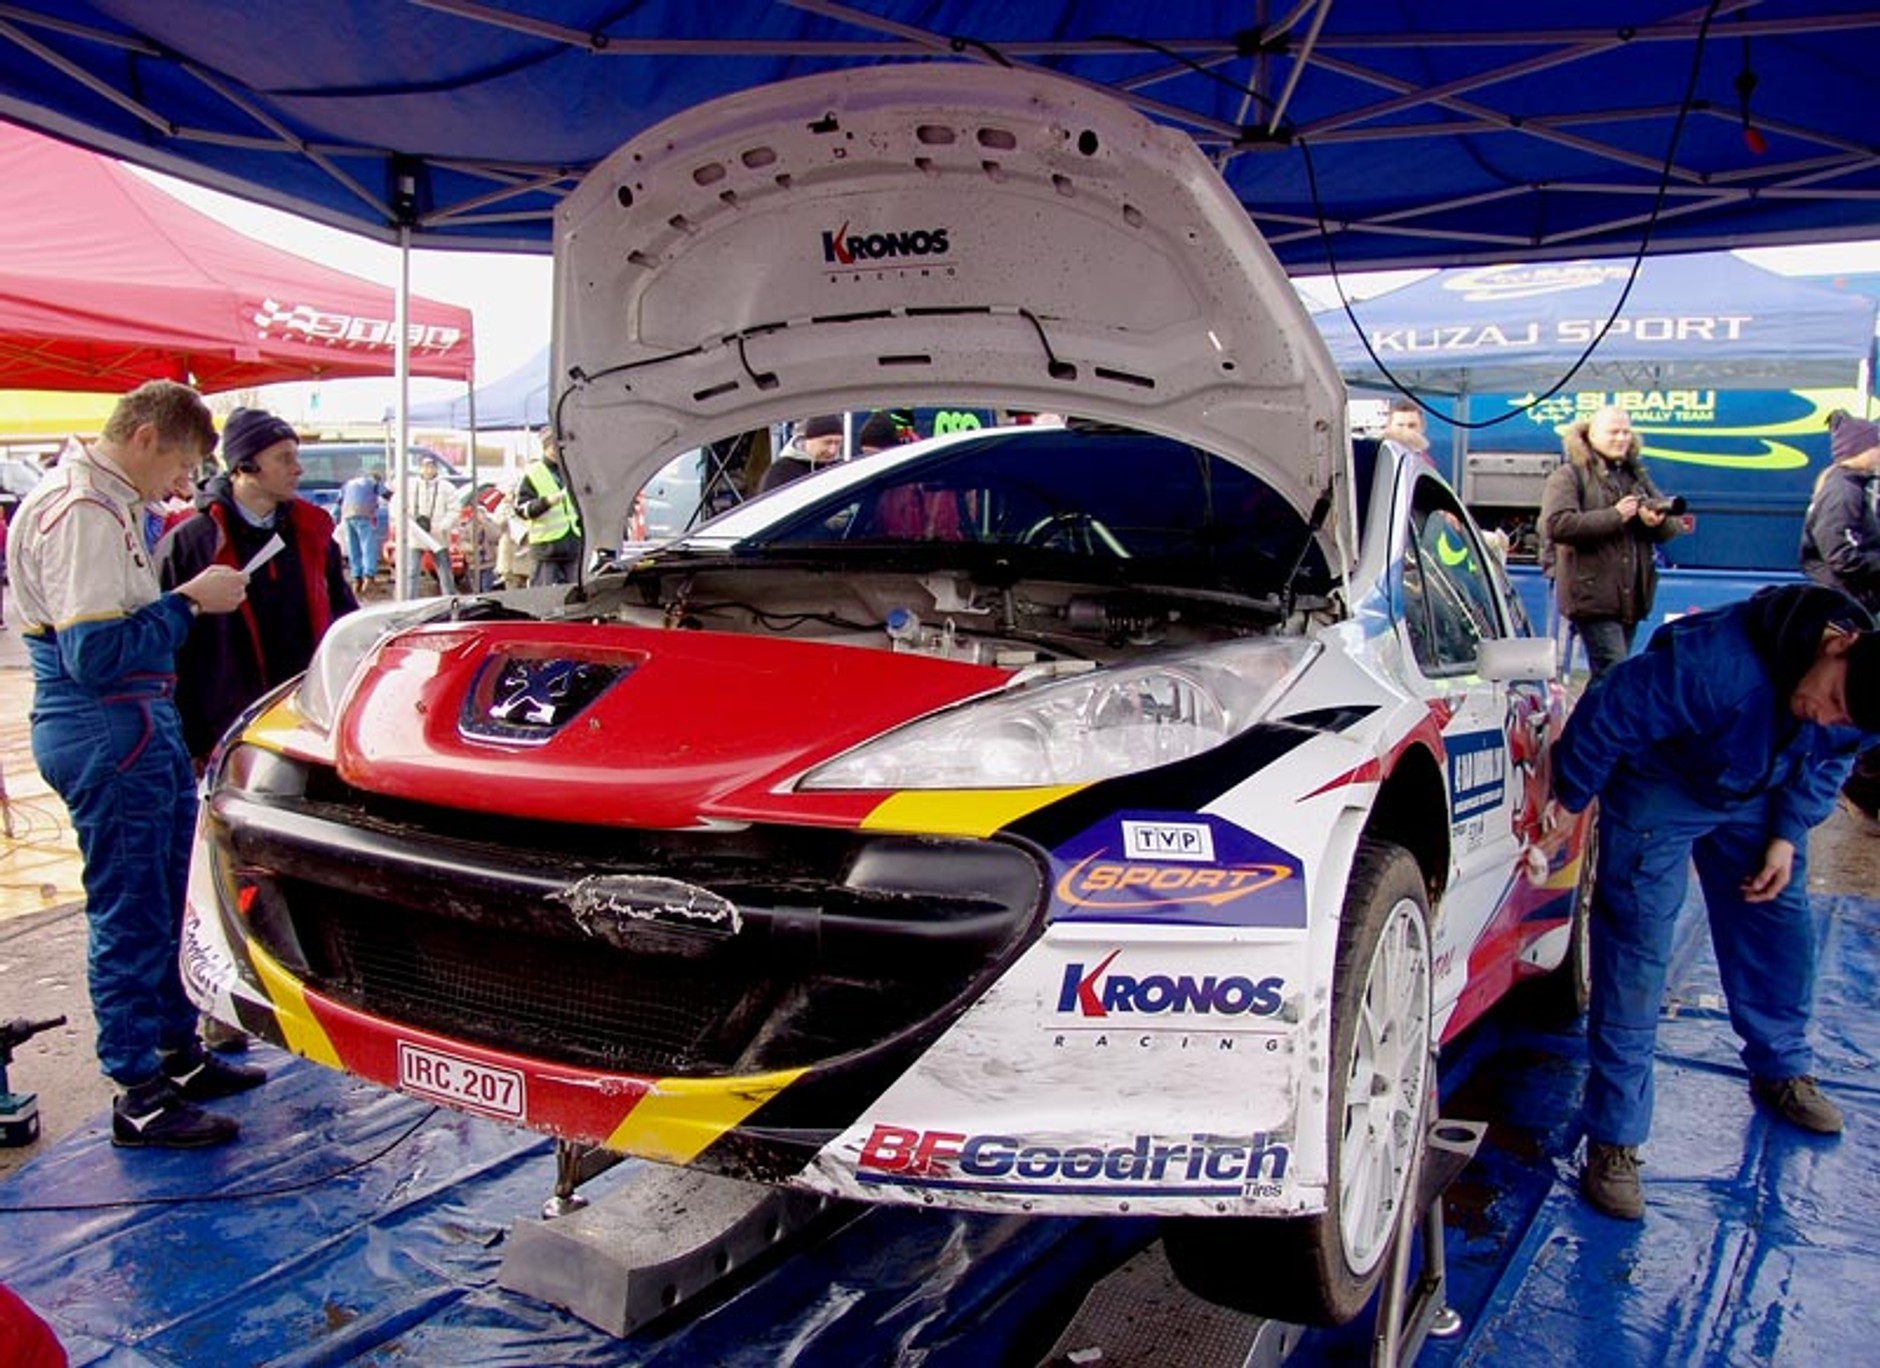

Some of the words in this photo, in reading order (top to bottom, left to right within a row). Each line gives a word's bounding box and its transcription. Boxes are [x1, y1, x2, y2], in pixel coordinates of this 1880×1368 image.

[822, 220, 949, 264] KRONOS
[1370, 322, 1539, 352] KUZAJ
[1556, 317, 1754, 344] SPORT
[1575, 389, 1716, 410] SUBARU
[1631, 410, 1672, 422] RALLY
[1673, 410, 1715, 422] TEAM
[1139, 830, 1196, 848] TVP
[1080, 864, 1261, 891] SPORT
[1057, 949, 1286, 1017] KRONOS
[1053, 1035, 1278, 1052] RACING
[407, 1053, 514, 1105] IRC.207
[857, 1123, 1290, 1181] BFGoodrich
[1243, 1183, 1283, 1198] Tires
